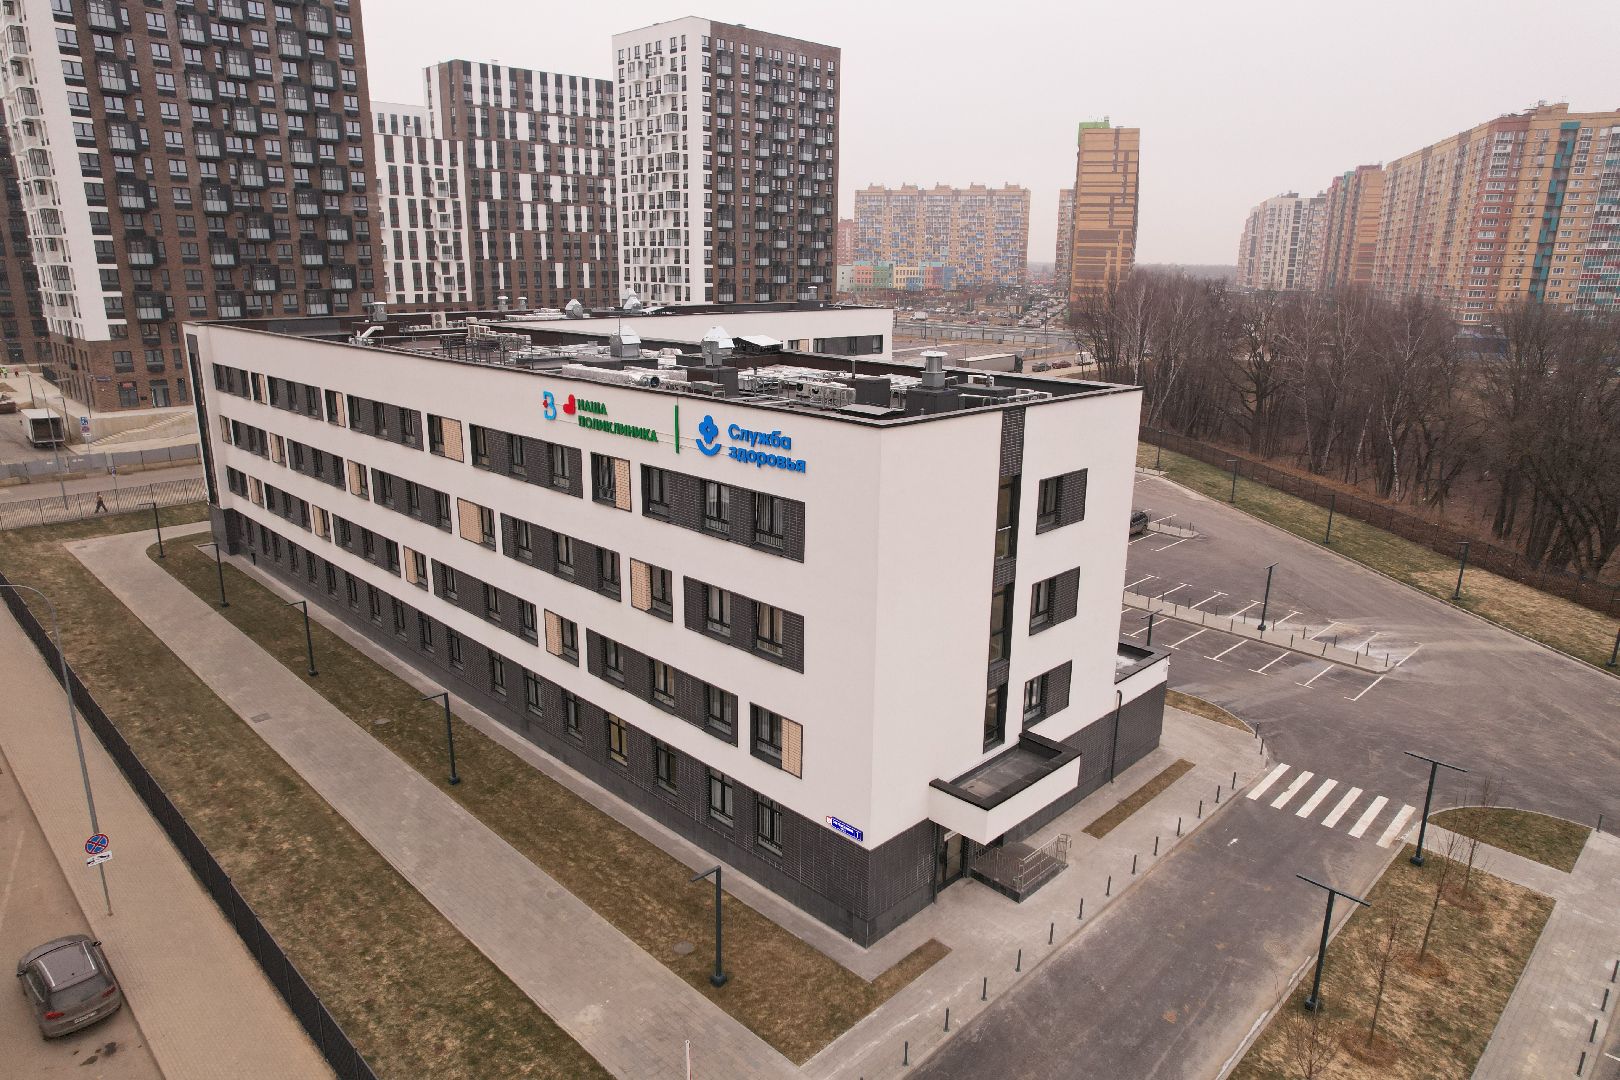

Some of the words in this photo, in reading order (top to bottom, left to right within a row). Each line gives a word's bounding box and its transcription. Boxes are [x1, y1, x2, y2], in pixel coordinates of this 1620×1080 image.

[577, 398, 608, 415] НАША
[578, 415, 659, 442] ПОЛИКЛИНИКА
[728, 423, 792, 450] Служба
[728, 446, 807, 473] здоровья
